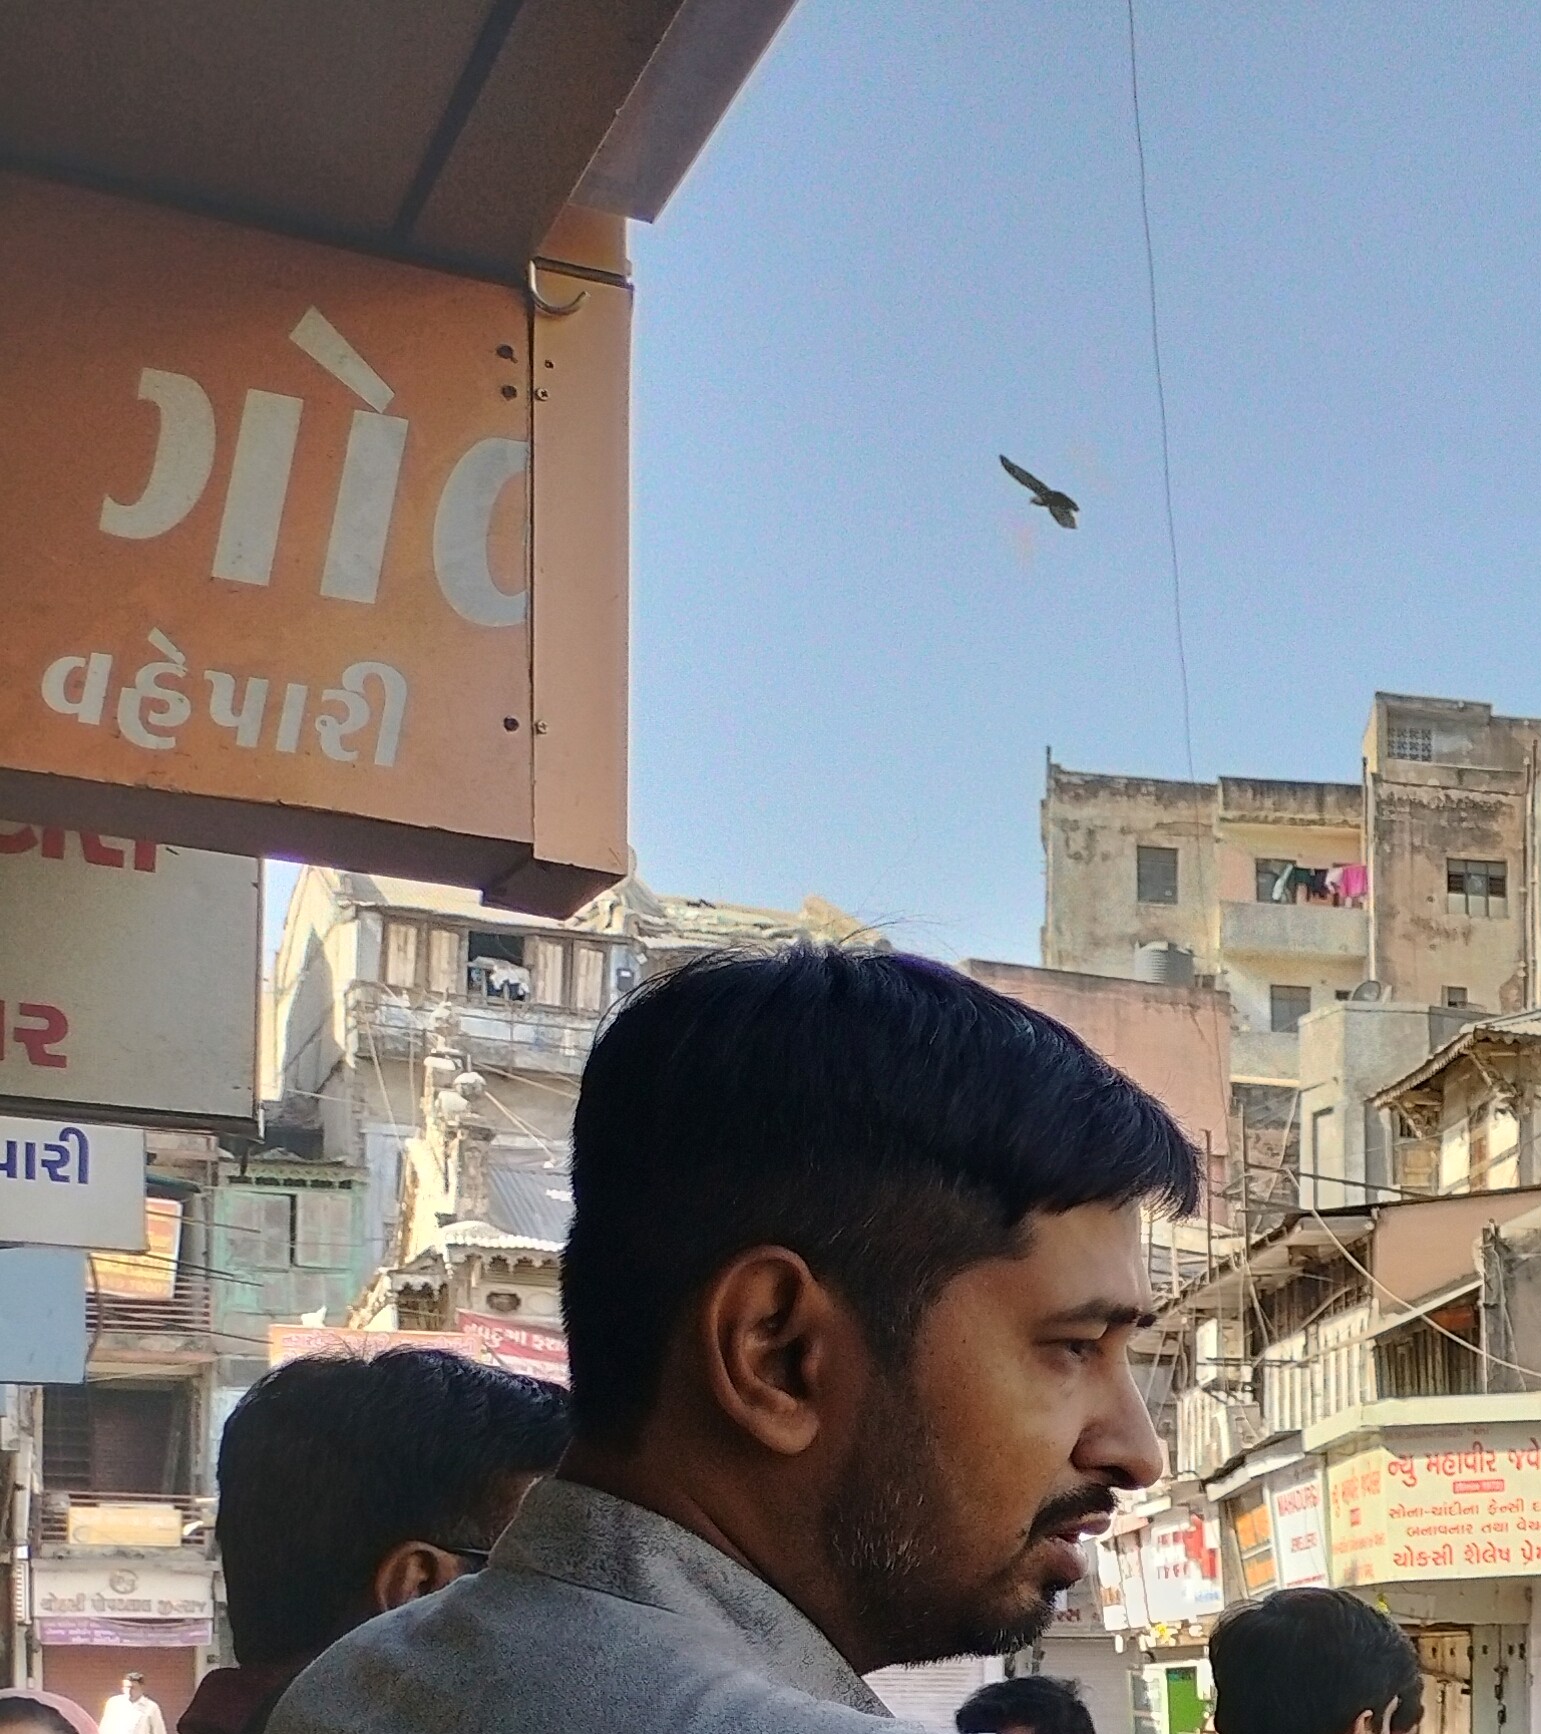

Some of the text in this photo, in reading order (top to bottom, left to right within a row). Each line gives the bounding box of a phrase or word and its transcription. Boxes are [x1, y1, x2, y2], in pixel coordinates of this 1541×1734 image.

[41, 627, 408, 767] વહેપારી
[1426, 1441, 1496, 1476] મહાવીર
[1407, 1523, 1473, 1537] બનાવનાર
[1481, 1521, 1508, 1533] તથા
[1393, 1543, 1453, 1567] ચોકસી
